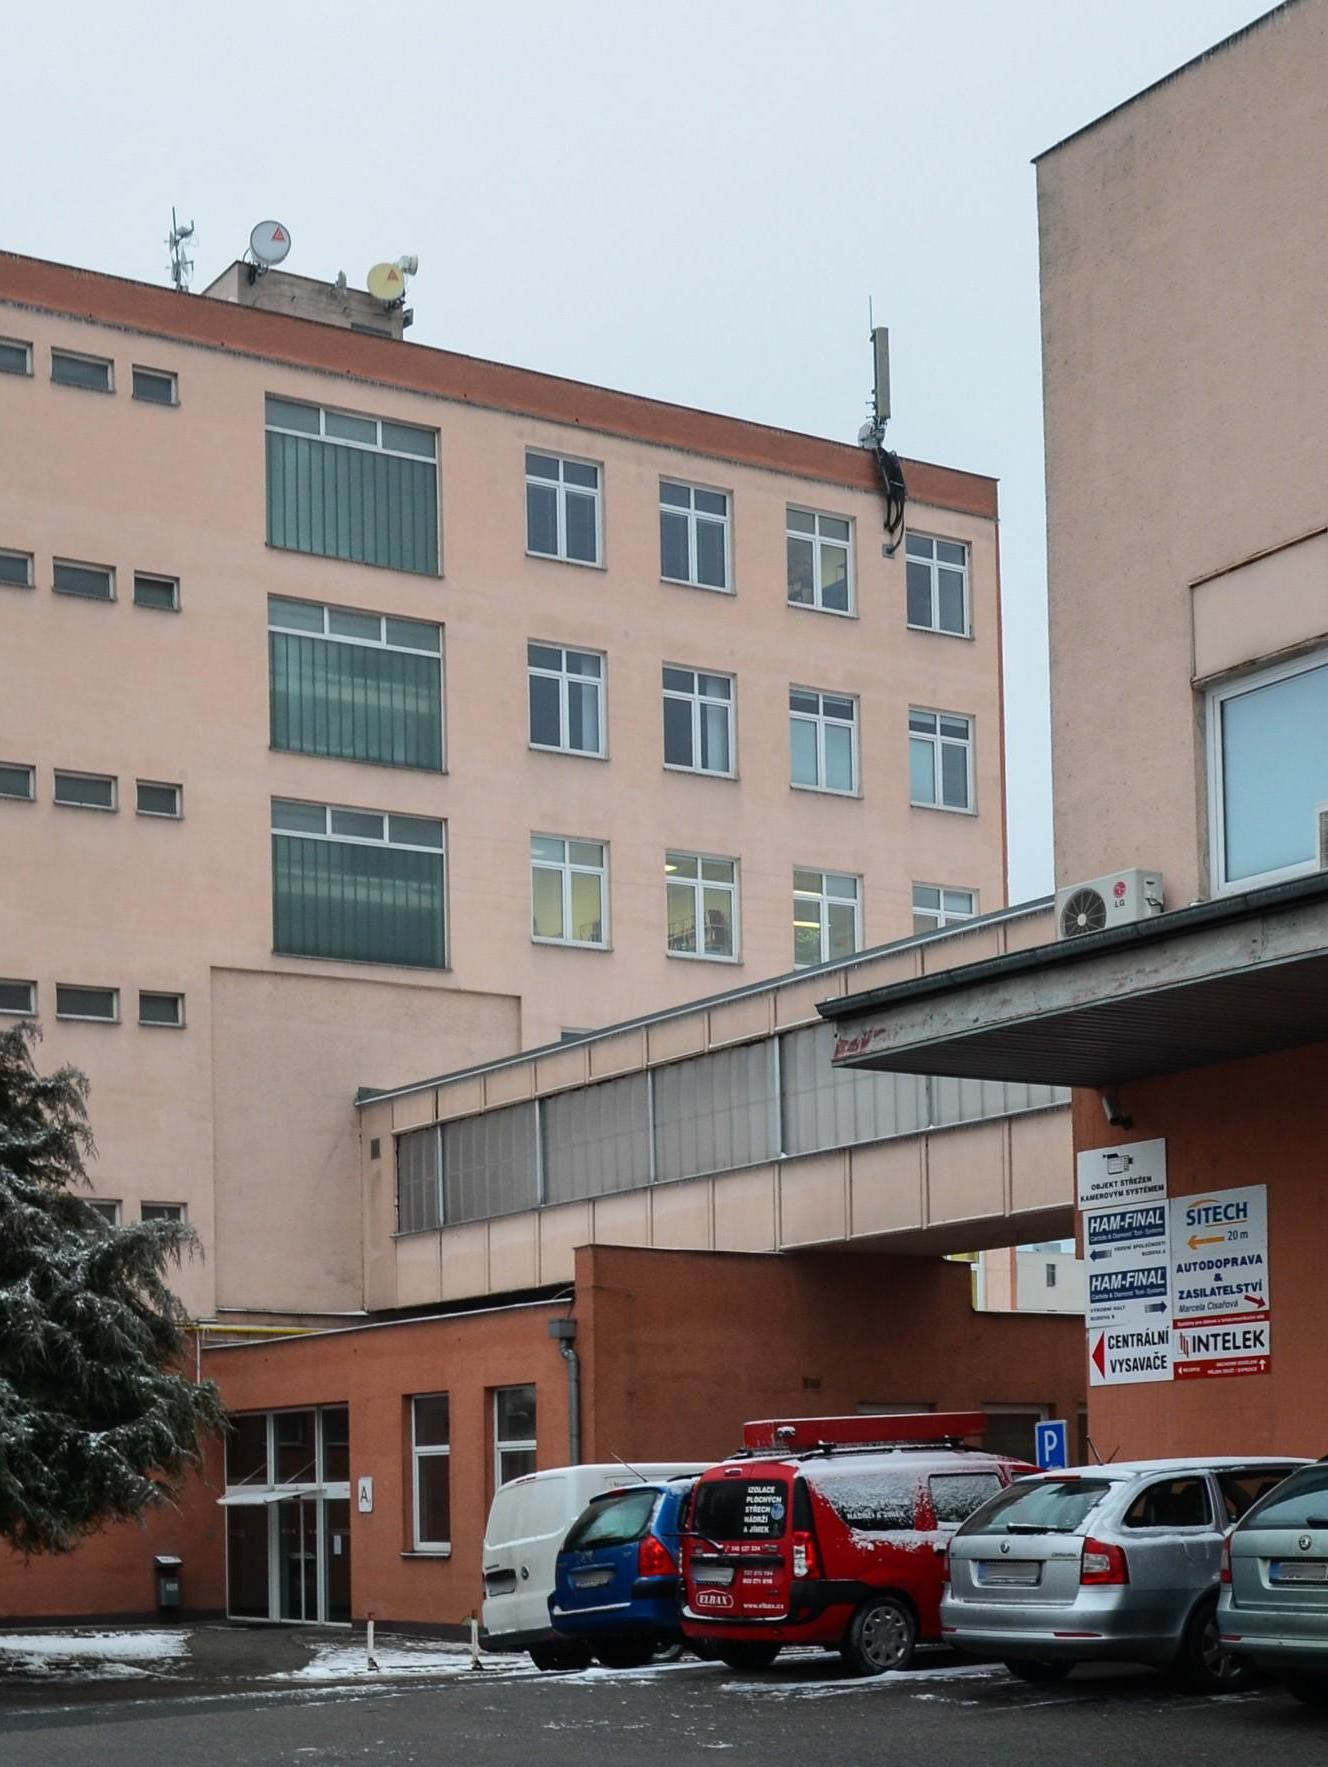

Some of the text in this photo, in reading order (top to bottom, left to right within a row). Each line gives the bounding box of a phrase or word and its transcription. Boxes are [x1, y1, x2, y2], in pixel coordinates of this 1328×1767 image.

[1114, 899, 1125, 908] LG
[1091, 1175, 1152, 1191] OBJEKT STŘEŽEN
[1125, 1184, 1164, 1196] SYSTÉMEM
[1186, 1201, 1248, 1226] SITECH
[1090, 1209, 1164, 1233] HAM-FINAL
[1227, 1230, 1249, 1241] 20 m
[1176, 1254, 1263, 1274] AUTODOPRAVA
[1092, 1269, 1165, 1291] HAM-FINAL
[1213, 1273, 1223, 1282] &
[1178, 1279, 1263, 1300] ZASILATELSTVÍ
[1179, 1304, 1206, 1313] Marcela
[1107, 1325, 1170, 1350] CENTRÁLNÍ
[1192, 1329, 1265, 1353] INTELEK
[1109, 1351, 1167, 1374] VYSAVAČE
[1044, 1430, 1058, 1462] P
[748, 1486, 776, 1494] IZOLACE
[746, 1495, 782, 1504] PLOCHÝCH
[744, 1505, 771, 1513] STŘECH
[744, 1515, 769, 1523] NÁDRŽÍ
[699, 1594, 728, 1605] ELBAX
